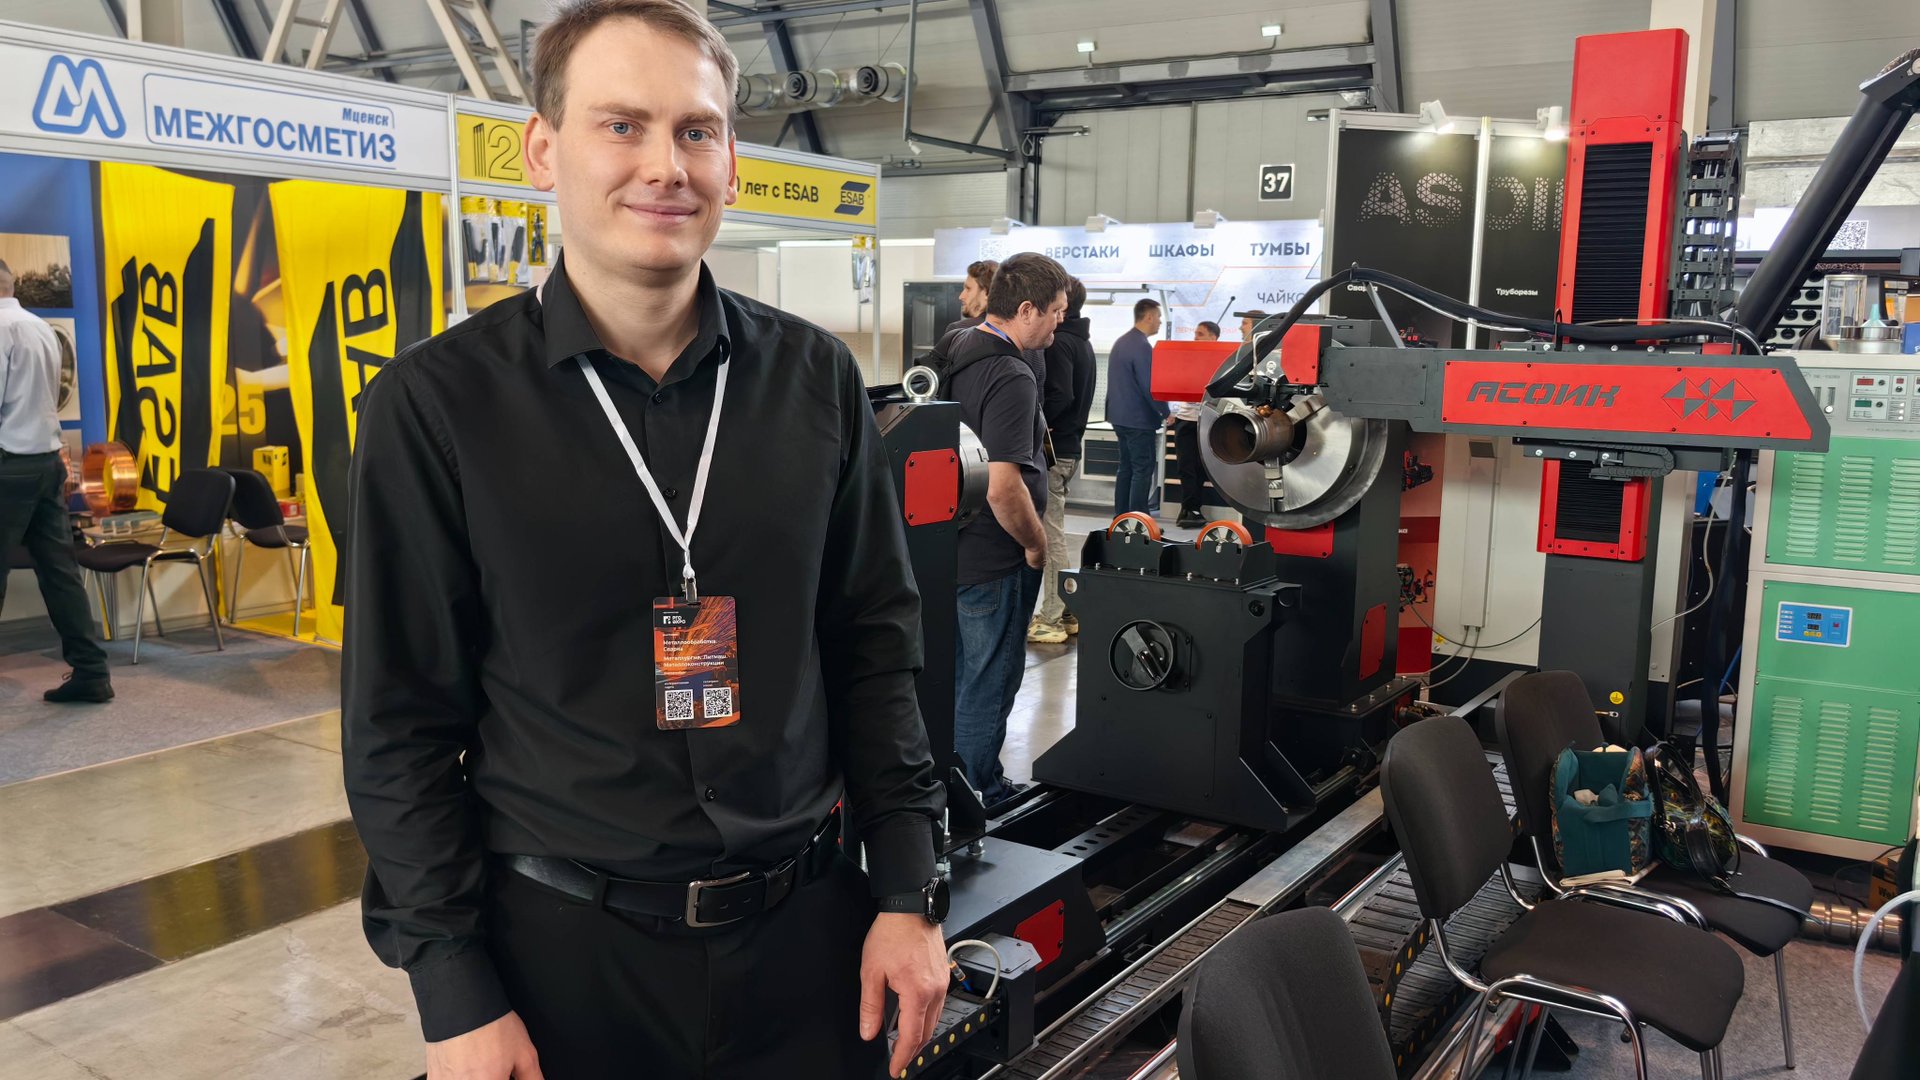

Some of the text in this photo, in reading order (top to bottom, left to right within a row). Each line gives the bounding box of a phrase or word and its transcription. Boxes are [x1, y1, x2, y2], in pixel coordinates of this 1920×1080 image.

[342, 107, 389, 126] Мценск
[153, 104, 396, 163] МЕЖГОСМЕТИЗ
[1263, 172, 1290, 193] 37
[745, 182, 768, 196] лет
[772, 185, 780, 198] с
[784, 182, 819, 203] ESAB
[840, 190, 865, 206] ESAB
[1045, 242, 1311, 258] ВЕРСТАКИ ШКАФЫ ТУМБЫ
[1496, 288, 1538, 296] Труборезы
